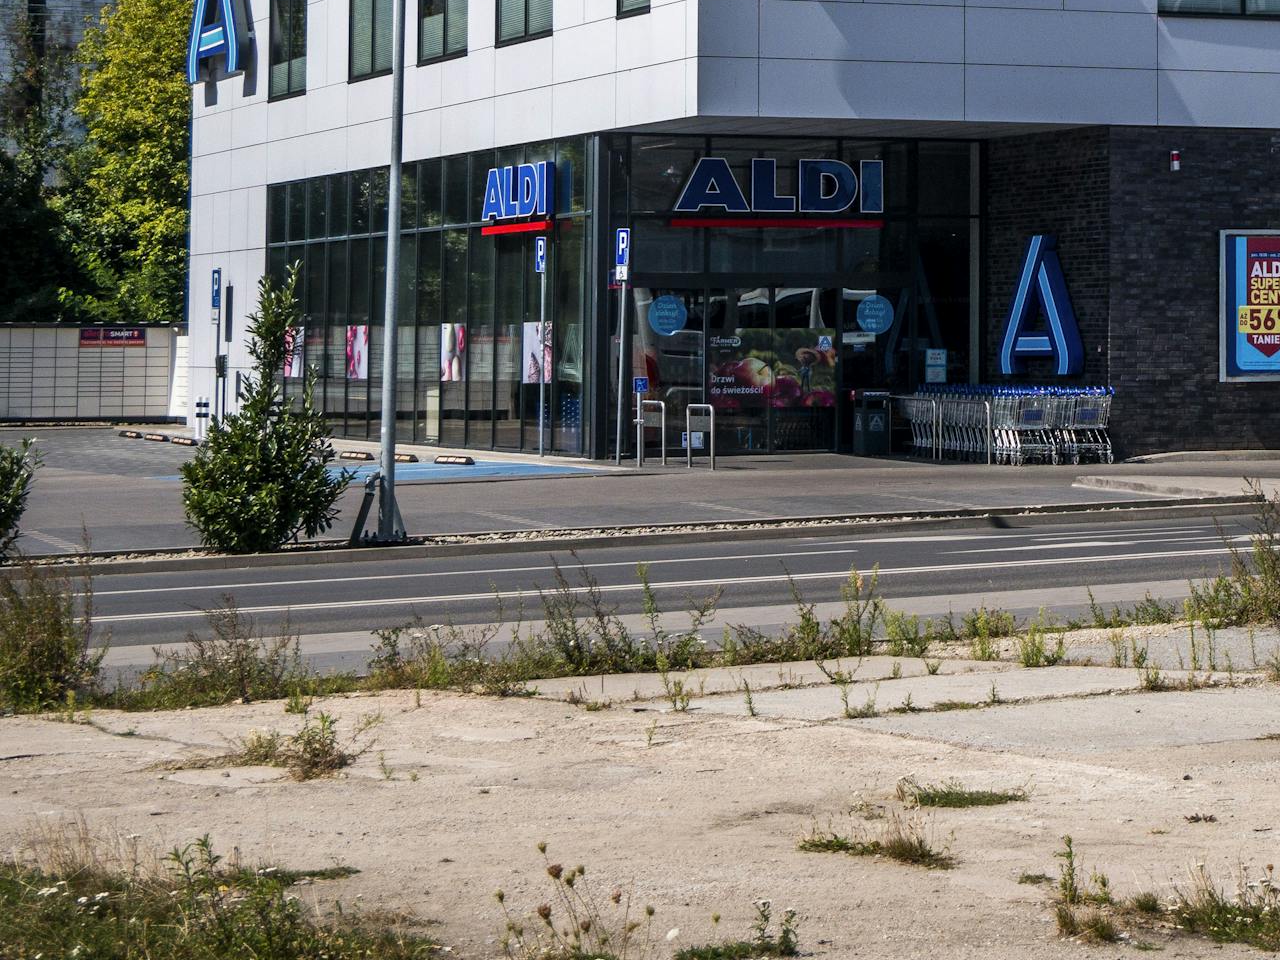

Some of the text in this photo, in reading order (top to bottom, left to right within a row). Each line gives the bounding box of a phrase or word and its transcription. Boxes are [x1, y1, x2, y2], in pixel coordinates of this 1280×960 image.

[481, 160, 548, 221] ALDI
[674, 157, 884, 213] ALDI
[537, 240, 545, 262] P
[619, 231, 628, 255] P
[711, 375, 735, 383] Drzwi
[711, 386, 721, 394] do
